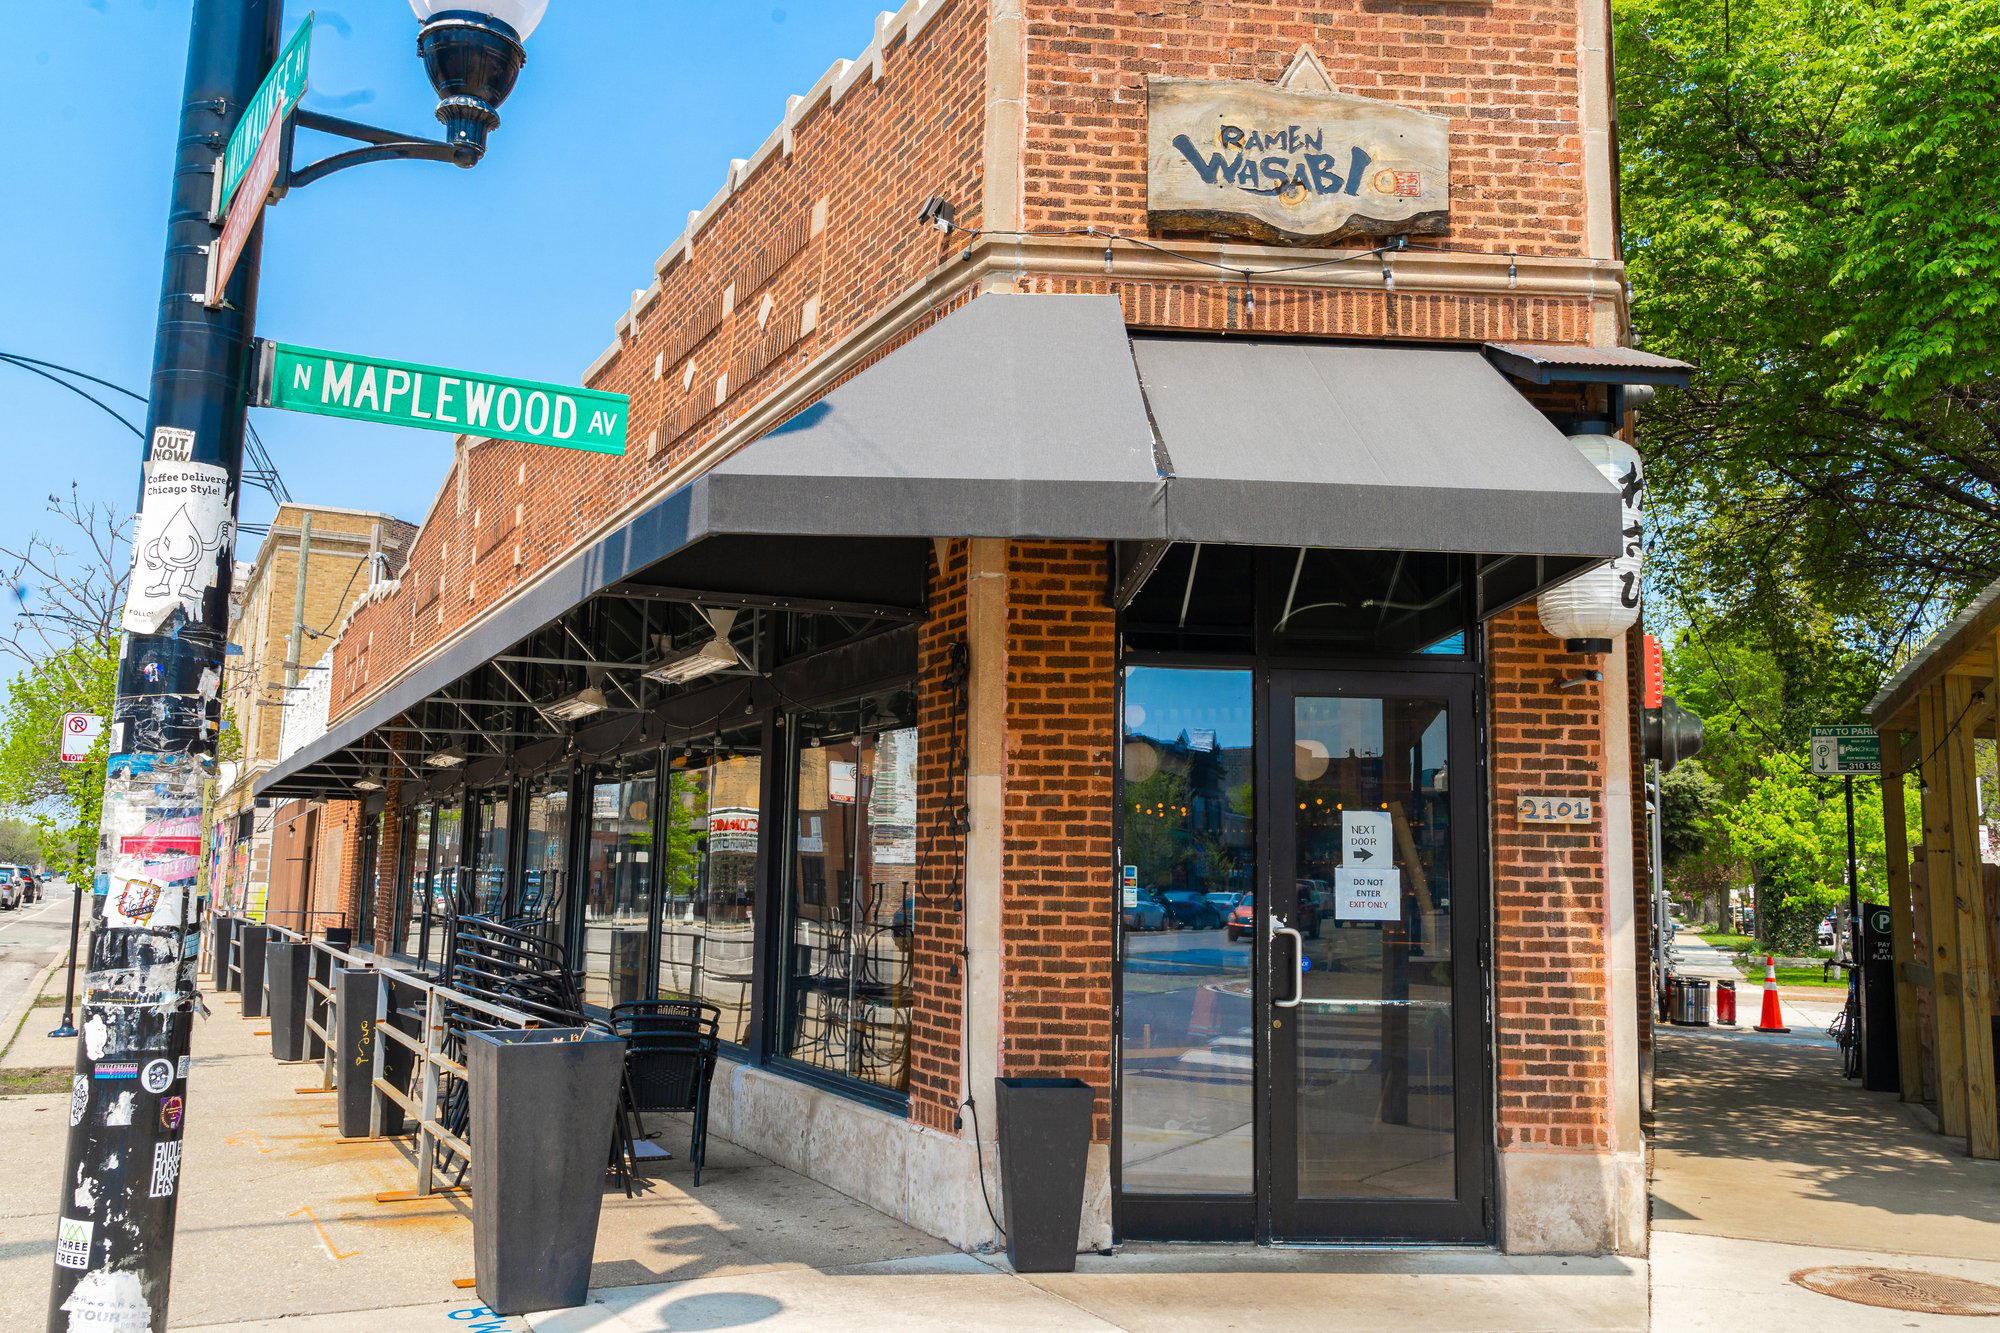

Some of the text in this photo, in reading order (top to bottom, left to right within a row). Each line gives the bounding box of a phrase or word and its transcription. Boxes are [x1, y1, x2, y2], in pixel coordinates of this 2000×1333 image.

[230, 50, 293, 188] MILWAUKEE
[1219, 124, 1323, 152] RAMEN
[1172, 134, 1371, 197] WASABI
[293, 359, 618, 440] N MAPLEWOOD AV
[157, 436, 189, 450] OUT
[152, 449, 190, 461] NOW
[147, 473, 179, 484] Coffee
[147, 485, 221, 496] Chicago Style!
[1815, 728, 1834, 736] PAY
[1836, 728, 1849, 736] TO
[1849, 762, 1865, 770] 310
[1519, 799, 1589, 819] 2101
[1351, 825, 1376, 835] NEXT
[1351, 838, 1377, 846] DOOR
[1353, 878, 1365, 886] DO
[1367, 901, 1388, 909] ONLY
[59, 1238, 89, 1251] THREE
[57, 1252, 86, 1266] TREES
